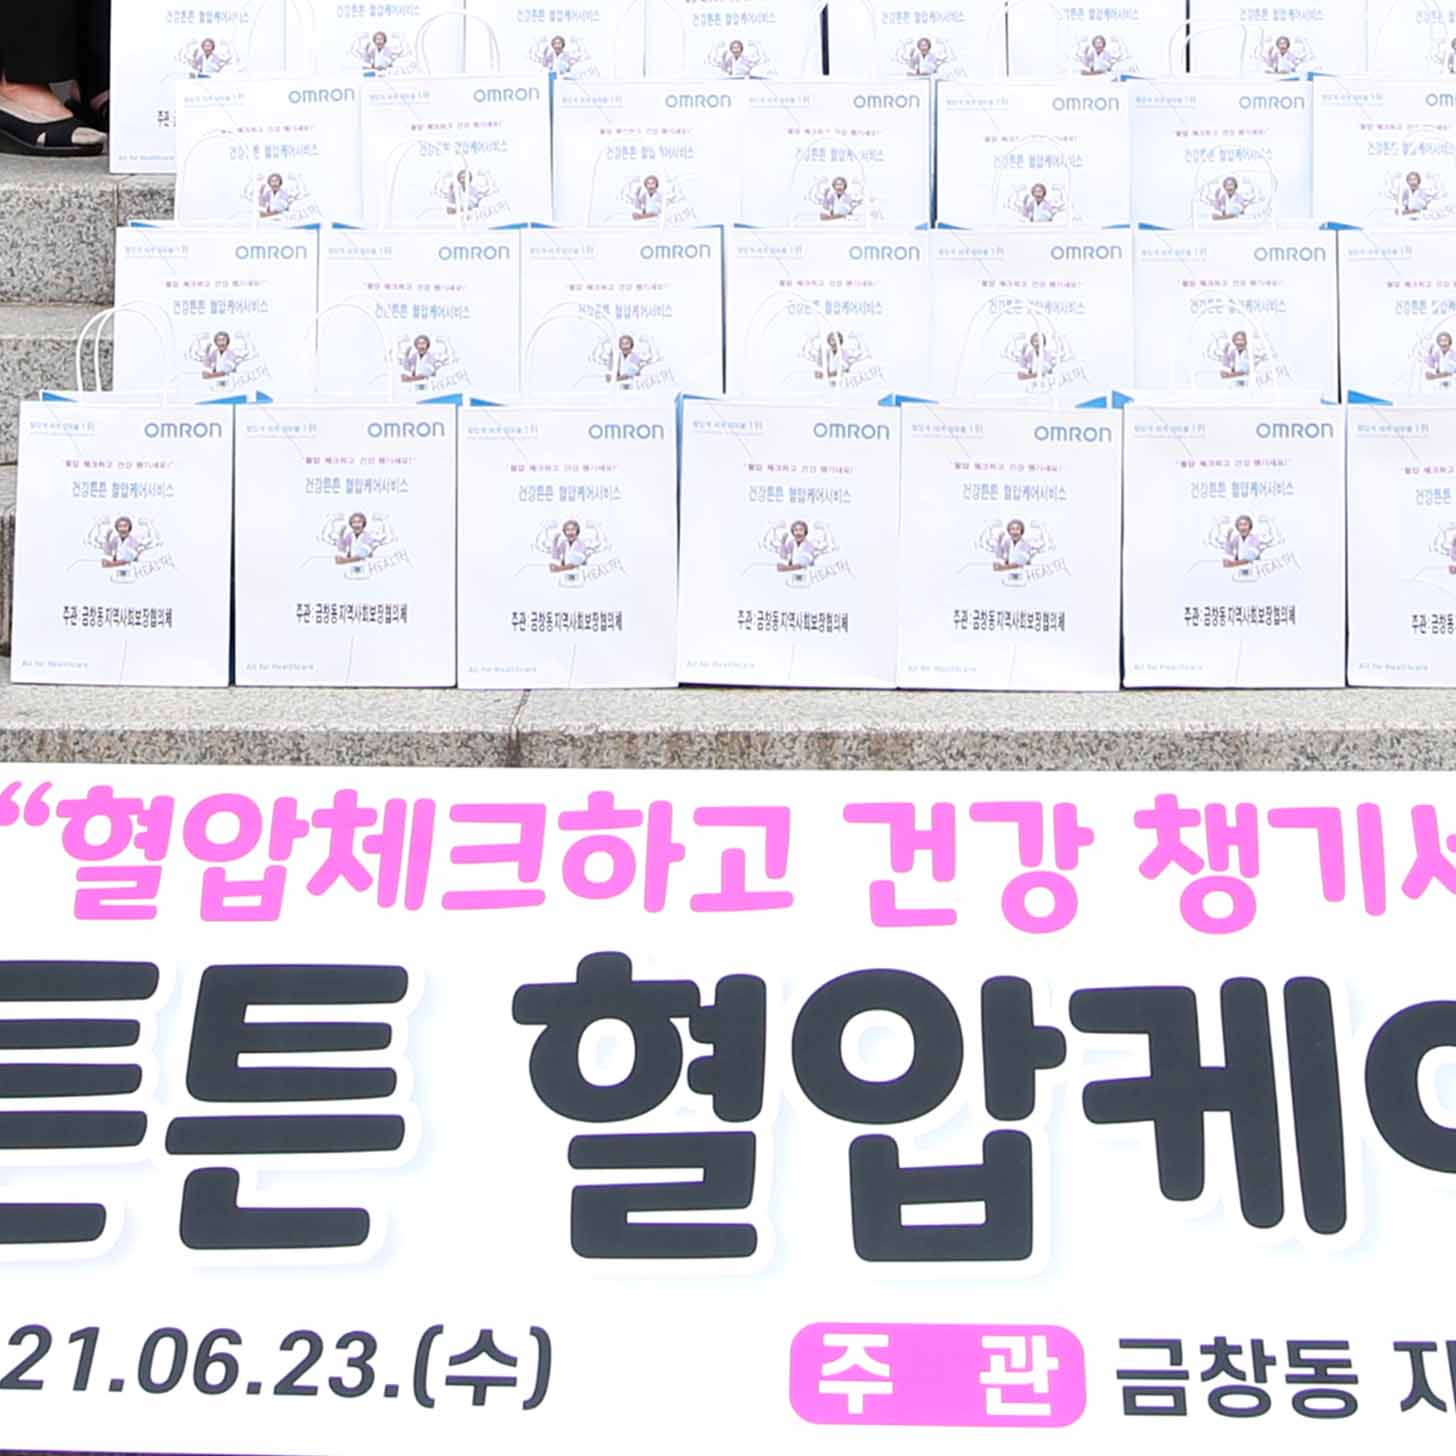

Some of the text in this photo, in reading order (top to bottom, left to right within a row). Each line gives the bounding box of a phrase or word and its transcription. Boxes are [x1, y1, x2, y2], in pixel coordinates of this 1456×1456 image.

[288, 88, 355, 104] OMRON
[473, 88, 539, 103] OMRON
[665, 94, 731, 108] OMRON
[853, 95, 920, 108] OMRON
[1239, 96, 1304, 110] OMRON
[1052, 97, 1119, 111] OMRON
[235, 245, 307, 259] OMRON
[438, 246, 510, 260] OMRON
[640, 244, 710, 259] OMRON
[849, 246, 920, 260] OMRON
[1051, 245, 1122, 260] OMRON
[1254, 247, 1326, 261] OMRON
[144, 422, 222, 438] OMRON
[368, 422, 445, 438] OMRON
[588, 424, 664, 439] OMRON
[813, 423, 890, 440] OMRON
[1034, 426, 1111, 442] OMRON
[1256, 423, 1333, 438] OMRON
[843, 800, 1095, 935] 건강
[1115, 1336, 1360, 1420] 금창동
